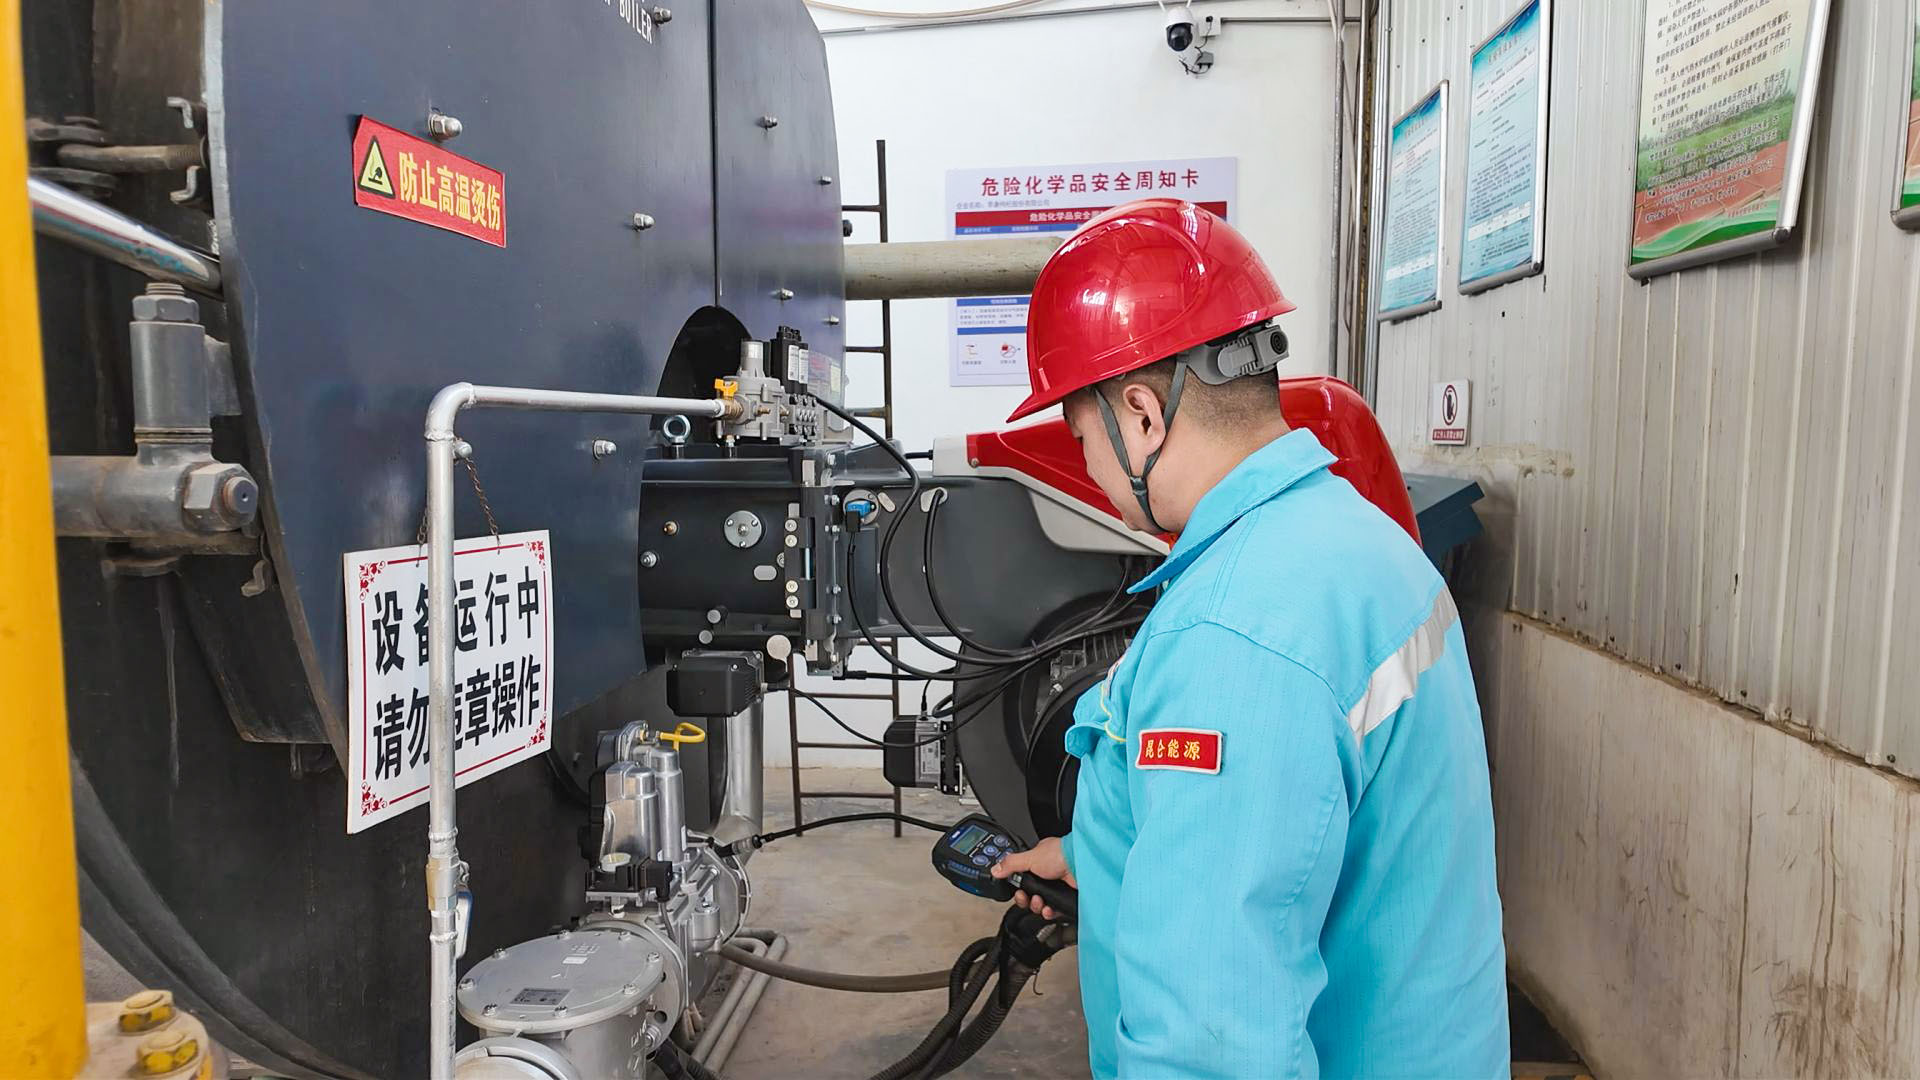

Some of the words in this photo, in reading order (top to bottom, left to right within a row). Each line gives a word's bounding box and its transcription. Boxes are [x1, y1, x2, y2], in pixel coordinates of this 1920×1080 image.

[399, 152, 501, 231] 防止高温烫伤
[982, 169, 1199, 197] 危险化学品安全周知卡
[1145, 738, 1201, 761] 昆仑能源
